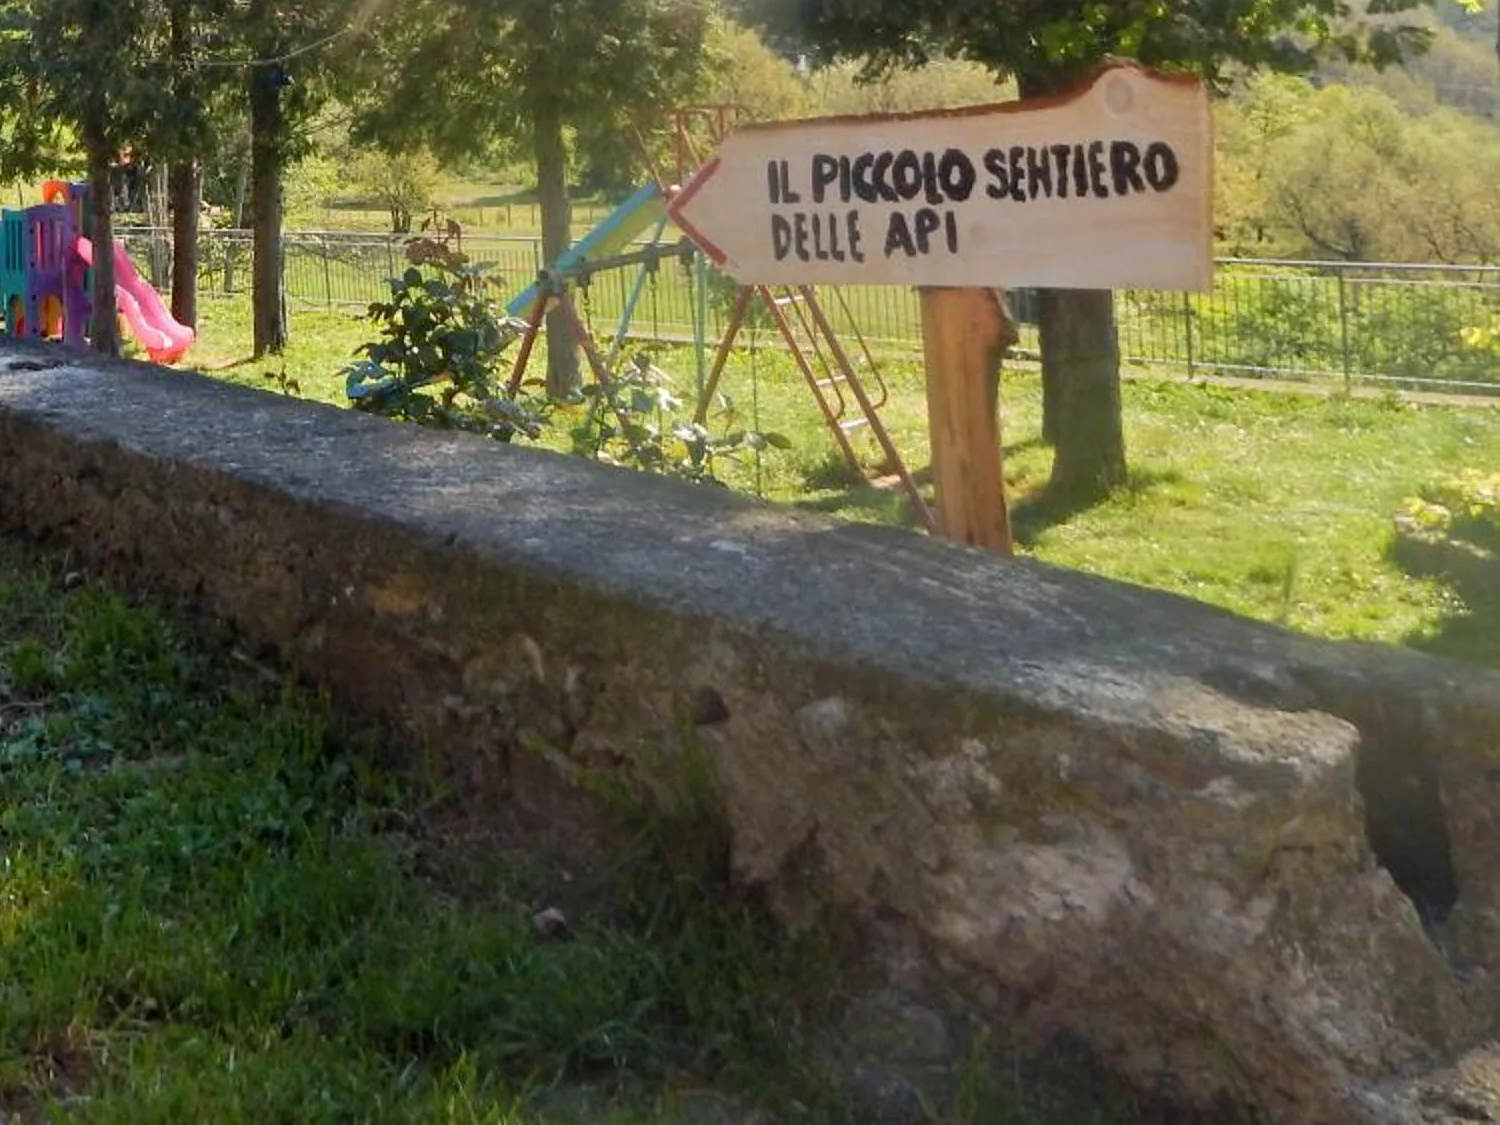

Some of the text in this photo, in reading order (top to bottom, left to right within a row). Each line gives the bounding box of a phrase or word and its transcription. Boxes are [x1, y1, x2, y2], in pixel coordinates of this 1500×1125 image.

[768, 141, 1181, 205] IL PICCOLO SENTIERO
[771, 207, 958, 263] DELLE API
